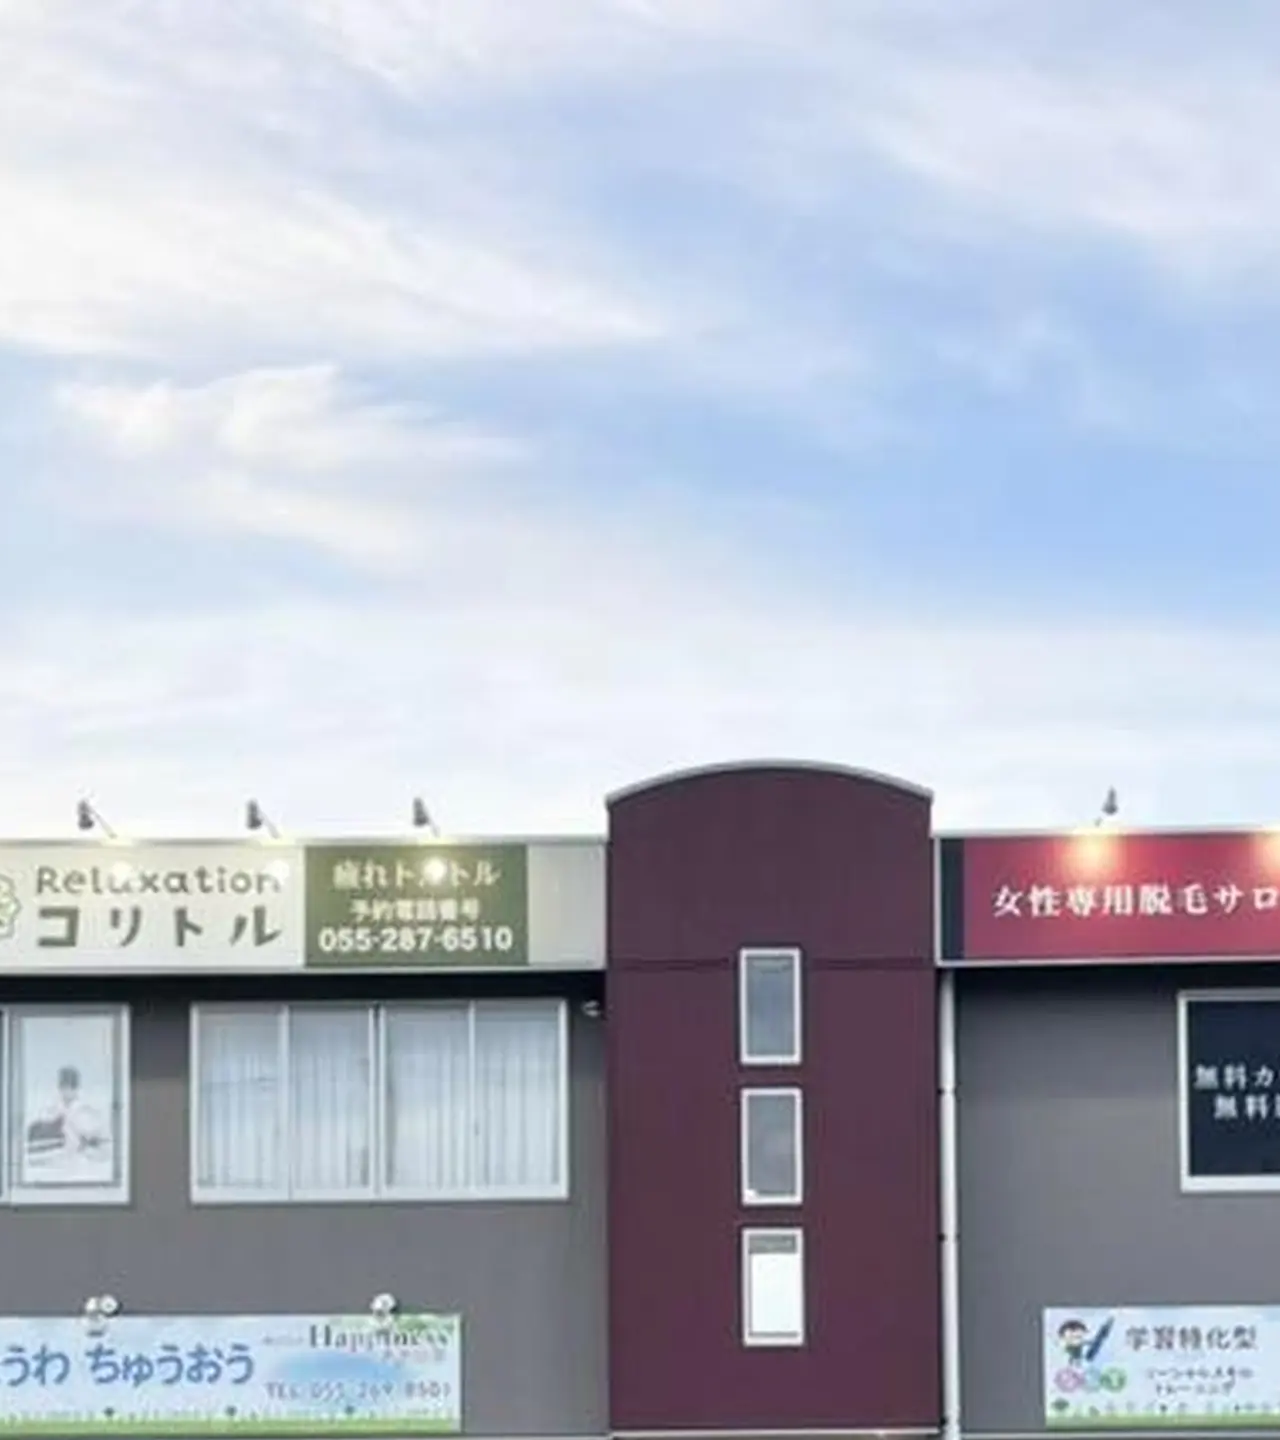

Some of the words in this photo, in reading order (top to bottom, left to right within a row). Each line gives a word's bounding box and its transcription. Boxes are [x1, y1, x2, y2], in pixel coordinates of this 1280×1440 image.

[36, 905, 282, 948] コリトル
[317, 925, 514, 953] 055-287-6510
[84, 1342, 256, 1388] ちゅうおう
